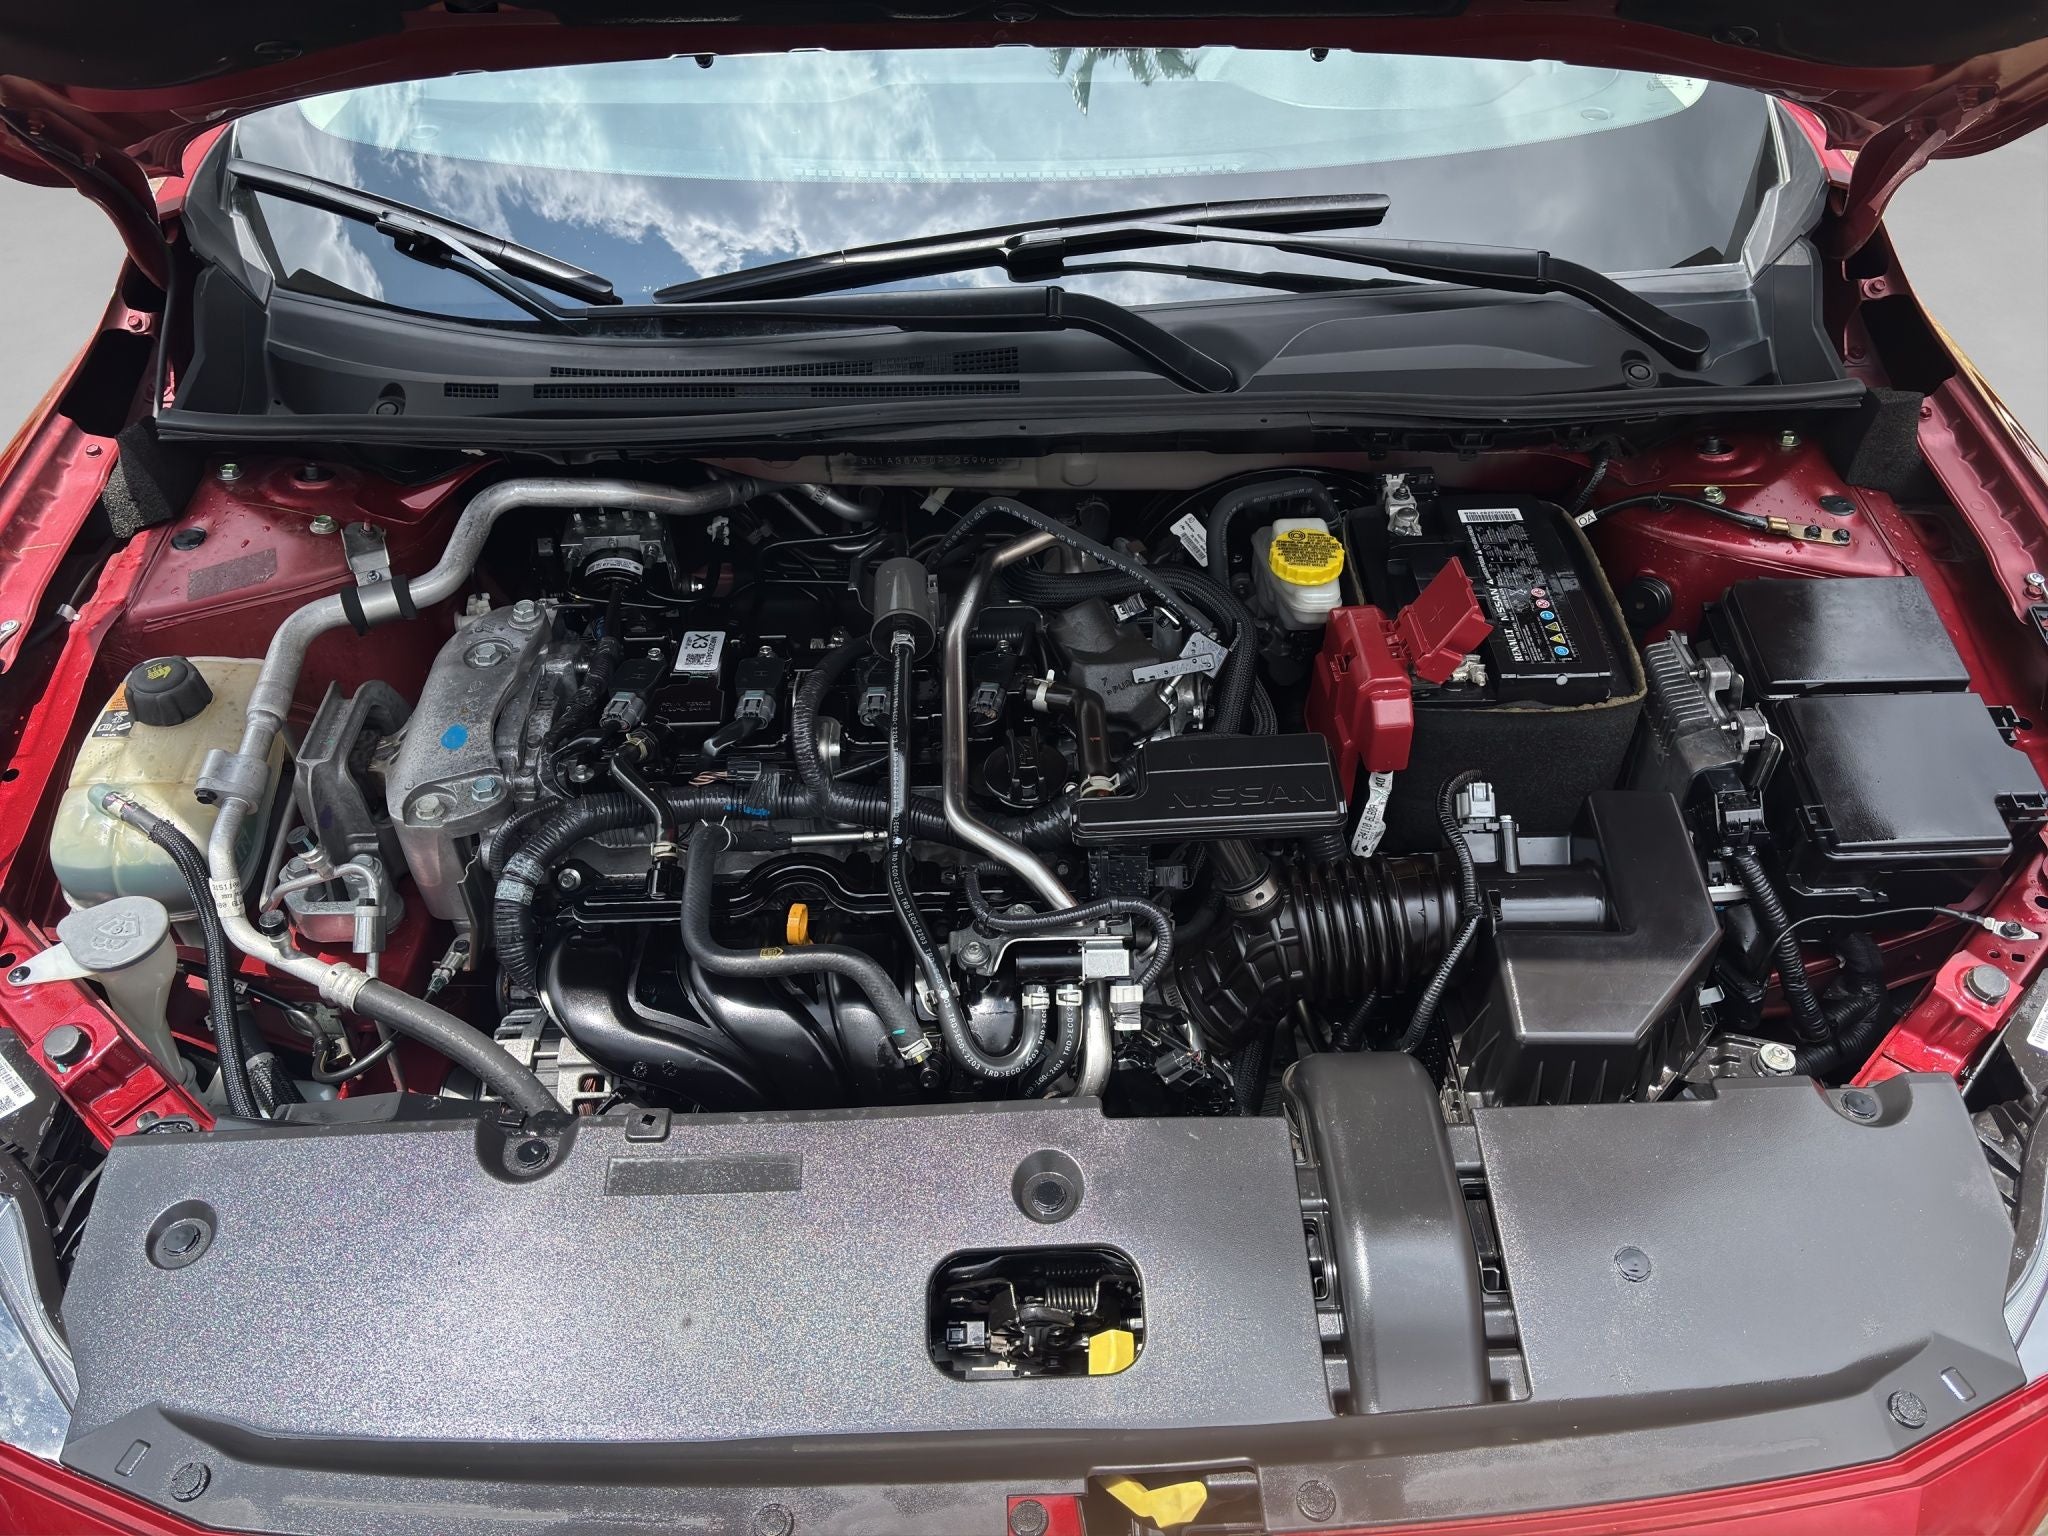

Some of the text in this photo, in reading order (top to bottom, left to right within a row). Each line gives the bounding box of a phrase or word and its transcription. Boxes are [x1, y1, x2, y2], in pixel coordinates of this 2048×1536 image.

[1489, 588, 1509, 621] NISSAN
[692, 634, 711, 648] X3
[1504, 628, 1524, 662] RENAULT
[1168, 783, 1328, 809] NISSAN
